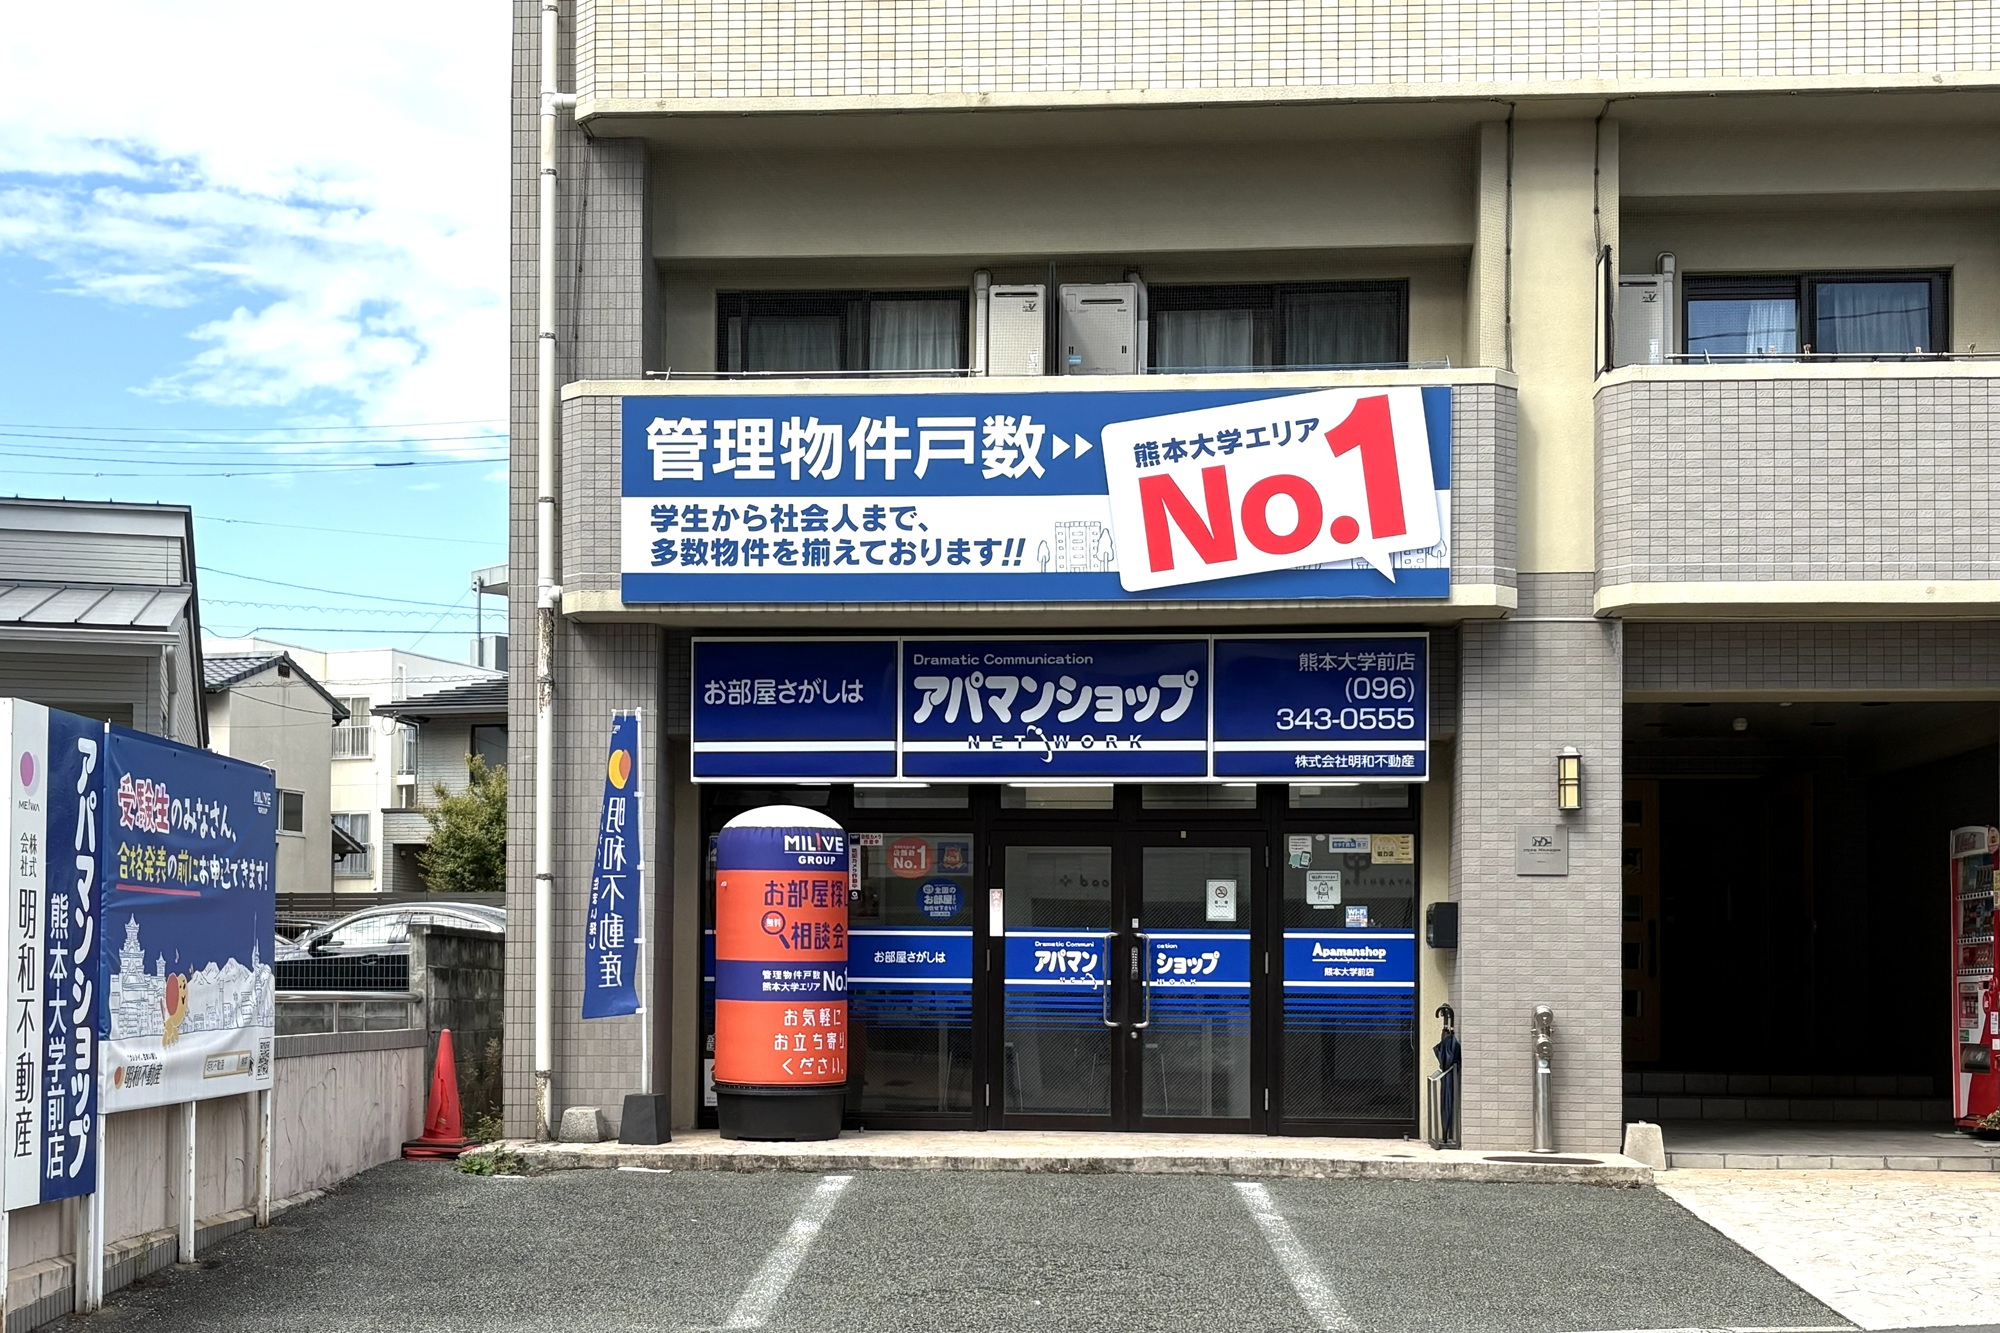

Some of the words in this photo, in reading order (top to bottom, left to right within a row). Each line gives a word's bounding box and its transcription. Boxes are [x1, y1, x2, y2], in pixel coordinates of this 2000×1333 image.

[645, 416, 1046, 482] 管理物件戸数
[1134, 417, 1320, 469] 熊本大学エリア
[1137, 394, 1407, 575] No.1
[650, 504, 930, 534] 学生から社会人まで、
[650, 536, 1025, 569] 多数物件を揃えております!!
[913, 653, 979, 666] Dramatic
[984, 653, 1094, 666] Communication
[1299, 651, 1416, 672] 熊本大学前店
[704, 678, 865, 706] お部屋さがしは
[913, 671, 1198, 723] アパマンショップ
[1344, 676, 1416, 704] (096)
[1276, 708, 1415, 731] 343-0555
[1295, 754, 1415, 769] 株式会社明和不動産
[118, 772, 236, 843] 受験生のみなさん、
[117, 841, 269, 891] 合格発表の前にお申込できます!
[798, 856, 836, 865] GROUP
[893, 845, 926, 869] No.1
[69, 737, 97, 1179] アパマンショップ
[874, 951, 945, 964] お部屋さがしは
[1034, 949, 1098, 973] アパマン
[1312, 942, 1386, 959] Apamanshop
[762, 969, 821, 980] 管理物件戸数
[1156, 951, 1220, 975] ショップ
[1324, 967, 1374, 977] 熊本大学前店
[762, 981, 821, 992] 熊本大学エリア
[14, 888, 37, 1159] 明和不動産
[784, 1008, 841, 1026] お気軽に
[45, 893, 69, 1179] 熊本大学前店
[774, 1032, 844, 1052] お立ち寄り
[124, 1062, 163, 1088] 明和不動産
